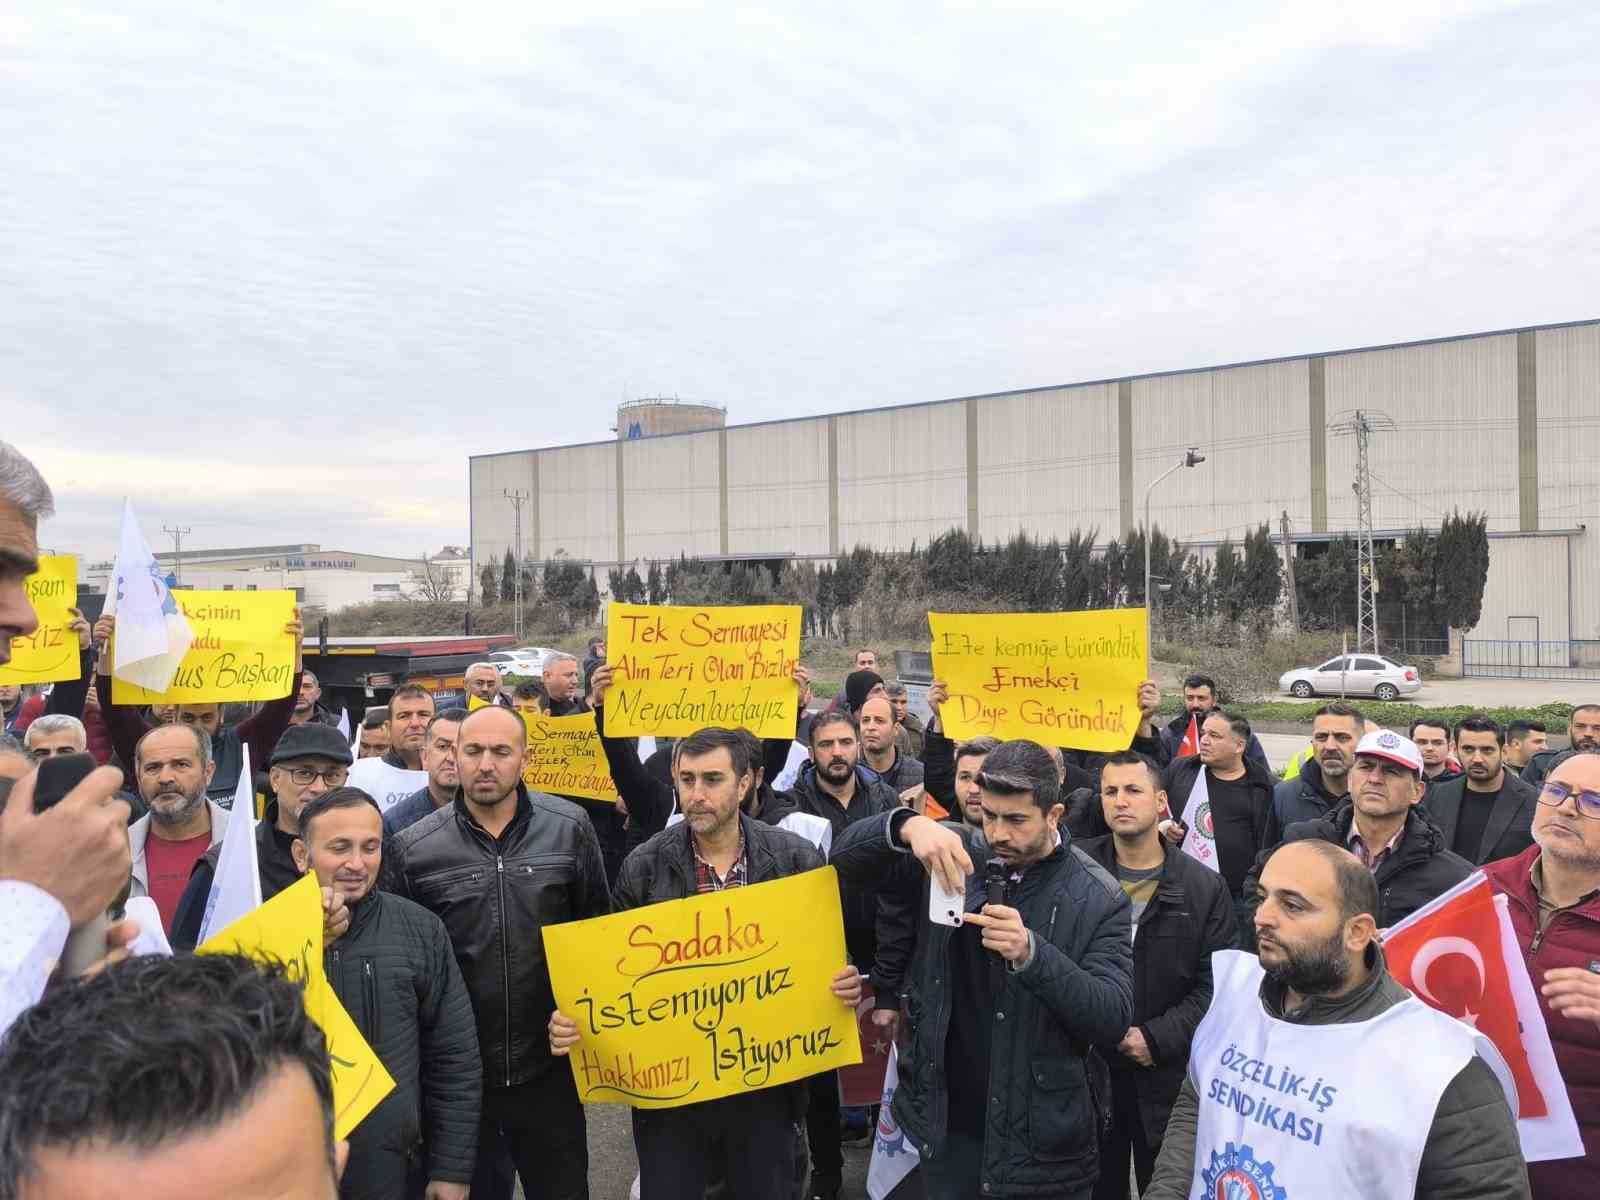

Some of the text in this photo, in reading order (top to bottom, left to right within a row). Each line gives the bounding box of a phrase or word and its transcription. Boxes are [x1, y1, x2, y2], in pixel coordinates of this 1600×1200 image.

[24, 578, 65, 603] şam
[182, 602, 241, 622] kçinin
[190, 628, 223, 650] udu
[621, 612, 788, 656] Tek Sermayesi
[1064, 624, 1142, 660] büründük
[172, 652, 291, 695] us Başkan
[609, 648, 797, 683] Alın Teri Olan Bizler
[982, 666, 1080, 693] Emekçi
[609, 685, 786, 733] Meydanlardayız
[947, 694, 1009, 732] Diye
[1018, 698, 1128, 736] Göründük
[522, 763, 616, 793] danlardayız
[527, 756, 570, 769] İZLER
[616, 906, 766, 977] Sadaka
[574, 966, 797, 1035] İstemiyoruz
[703, 1019, 843, 1087] İstiyoruz
[1220, 1043, 1338, 1113] ÖZÇELİK-İŞ
[1207, 1077, 1324, 1147] SENDİKASI
